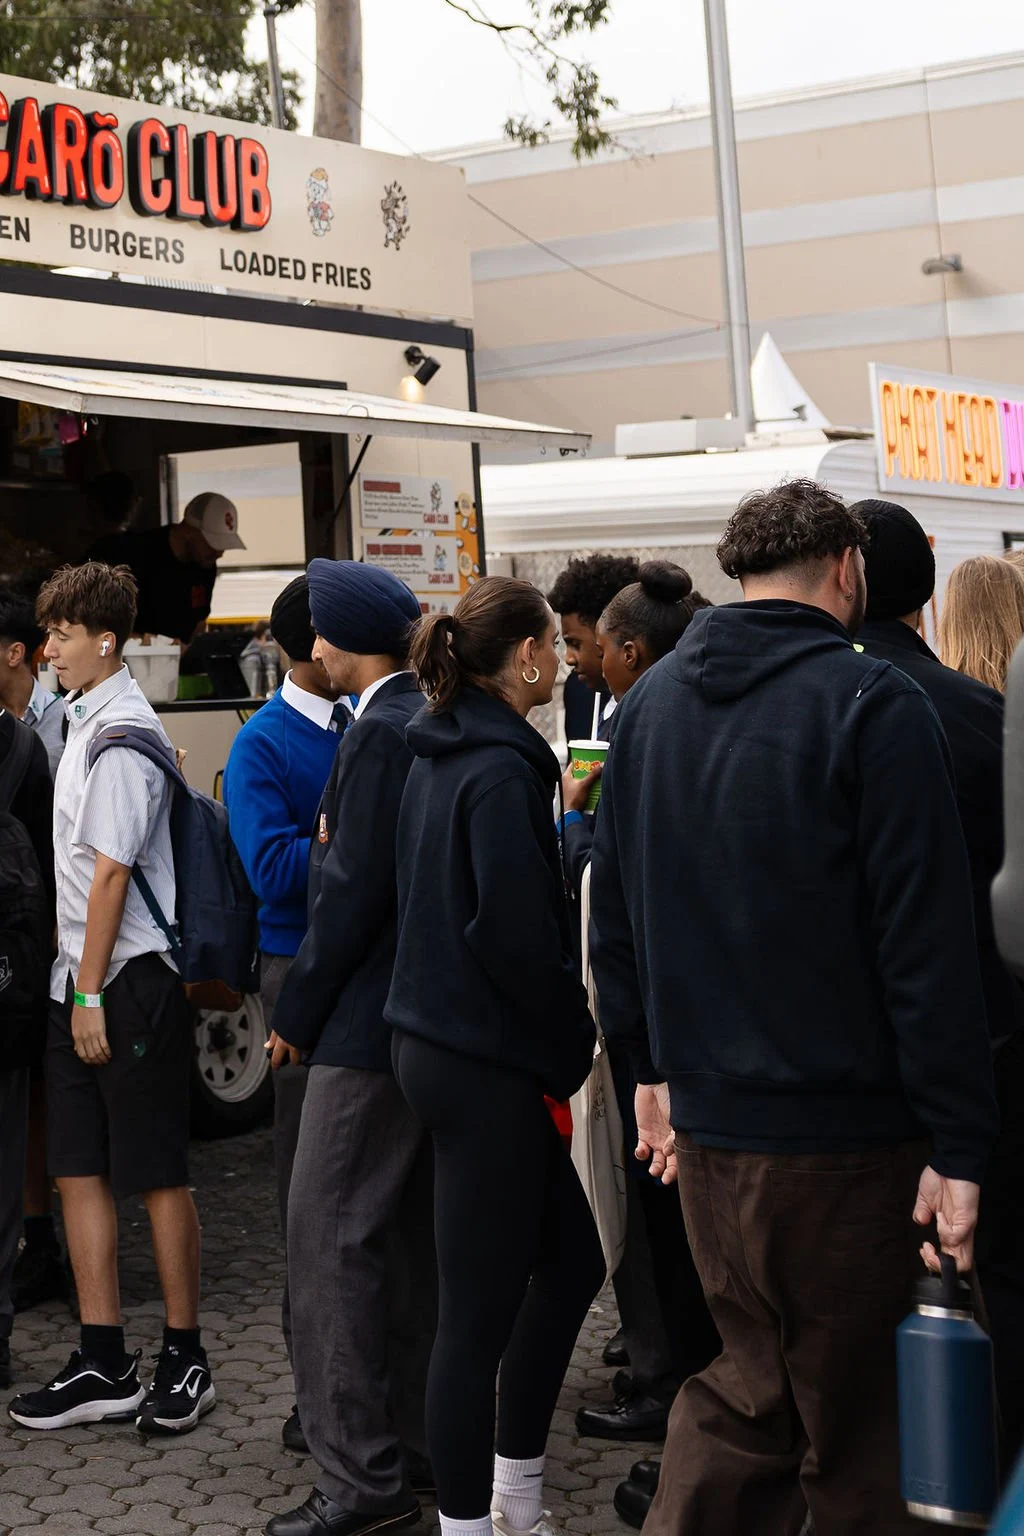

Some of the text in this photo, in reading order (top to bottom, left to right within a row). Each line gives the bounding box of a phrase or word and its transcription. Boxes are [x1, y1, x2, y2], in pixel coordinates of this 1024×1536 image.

[127, 117, 272, 231] CLUB
[69, 223, 185, 265] BURGERS
[219, 248, 372, 291] LOADED FRIES
